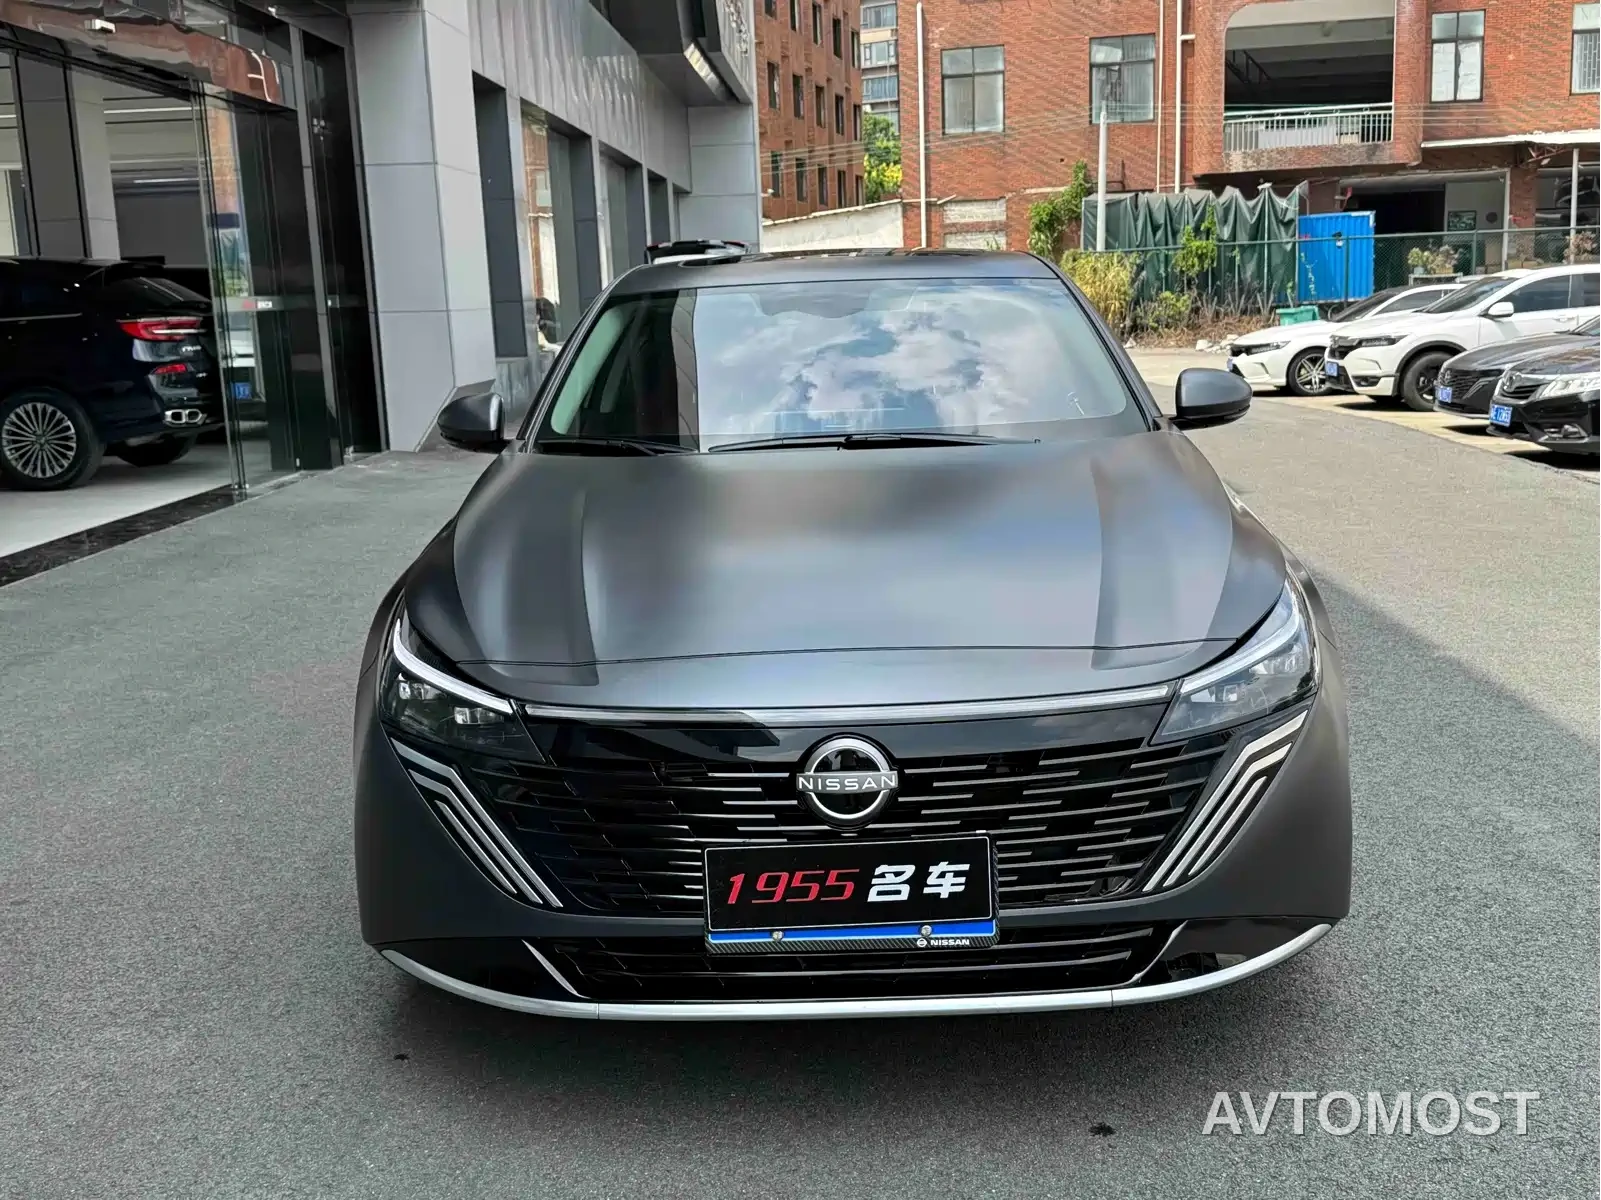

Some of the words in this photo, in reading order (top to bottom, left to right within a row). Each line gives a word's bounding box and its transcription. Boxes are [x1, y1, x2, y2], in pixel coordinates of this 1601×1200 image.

[798, 774, 896, 791] NISSAN
[726, 868, 860, 905] 1955
[866, 861, 971, 903] 名车
[930, 938, 970, 947] NISSAN
